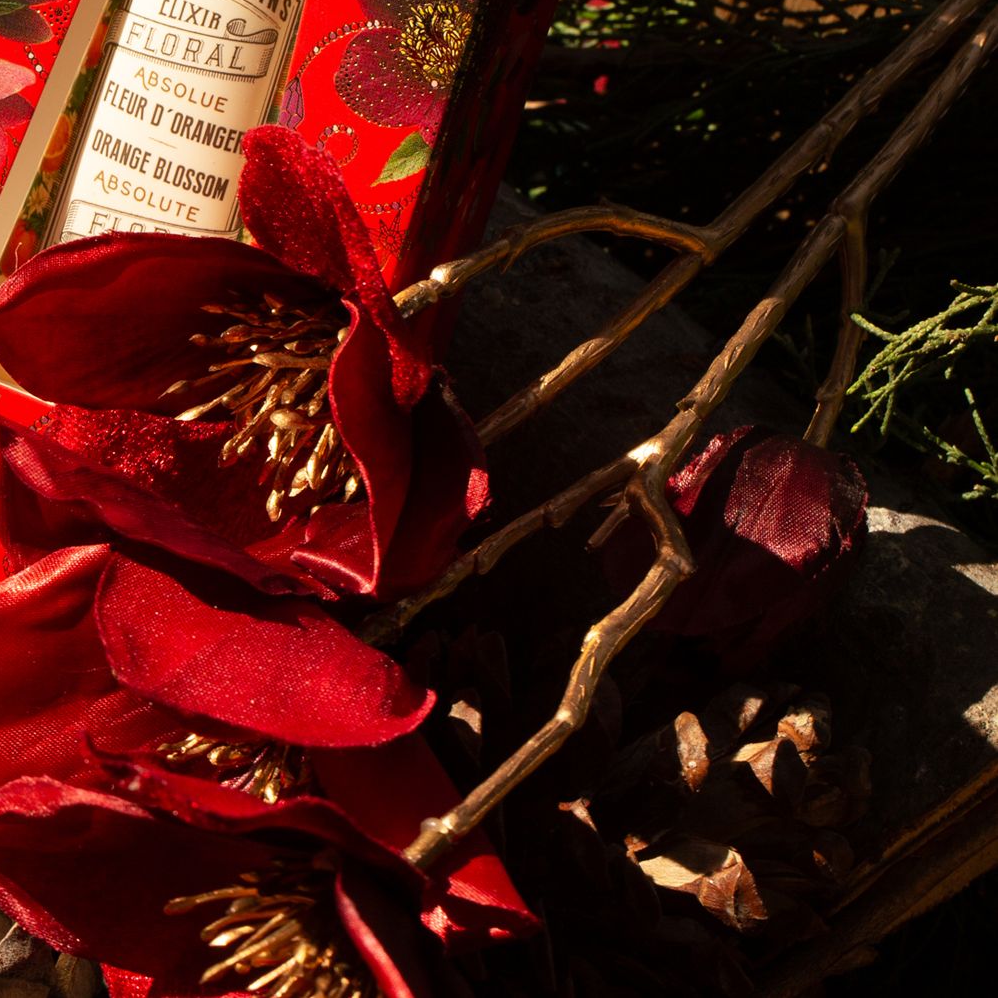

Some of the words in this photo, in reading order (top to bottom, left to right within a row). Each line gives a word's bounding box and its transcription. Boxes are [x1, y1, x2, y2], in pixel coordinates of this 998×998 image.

[126, 22, 245, 71] FLORAL
[103, 80, 147, 121] FLEUR
[134, 67, 228, 113] ABSOLUE
[92, 129, 151, 174] ORANGE
[153, 157, 229, 201] BLOSSOM
[94, 170, 200, 222] ABSOLUTE
